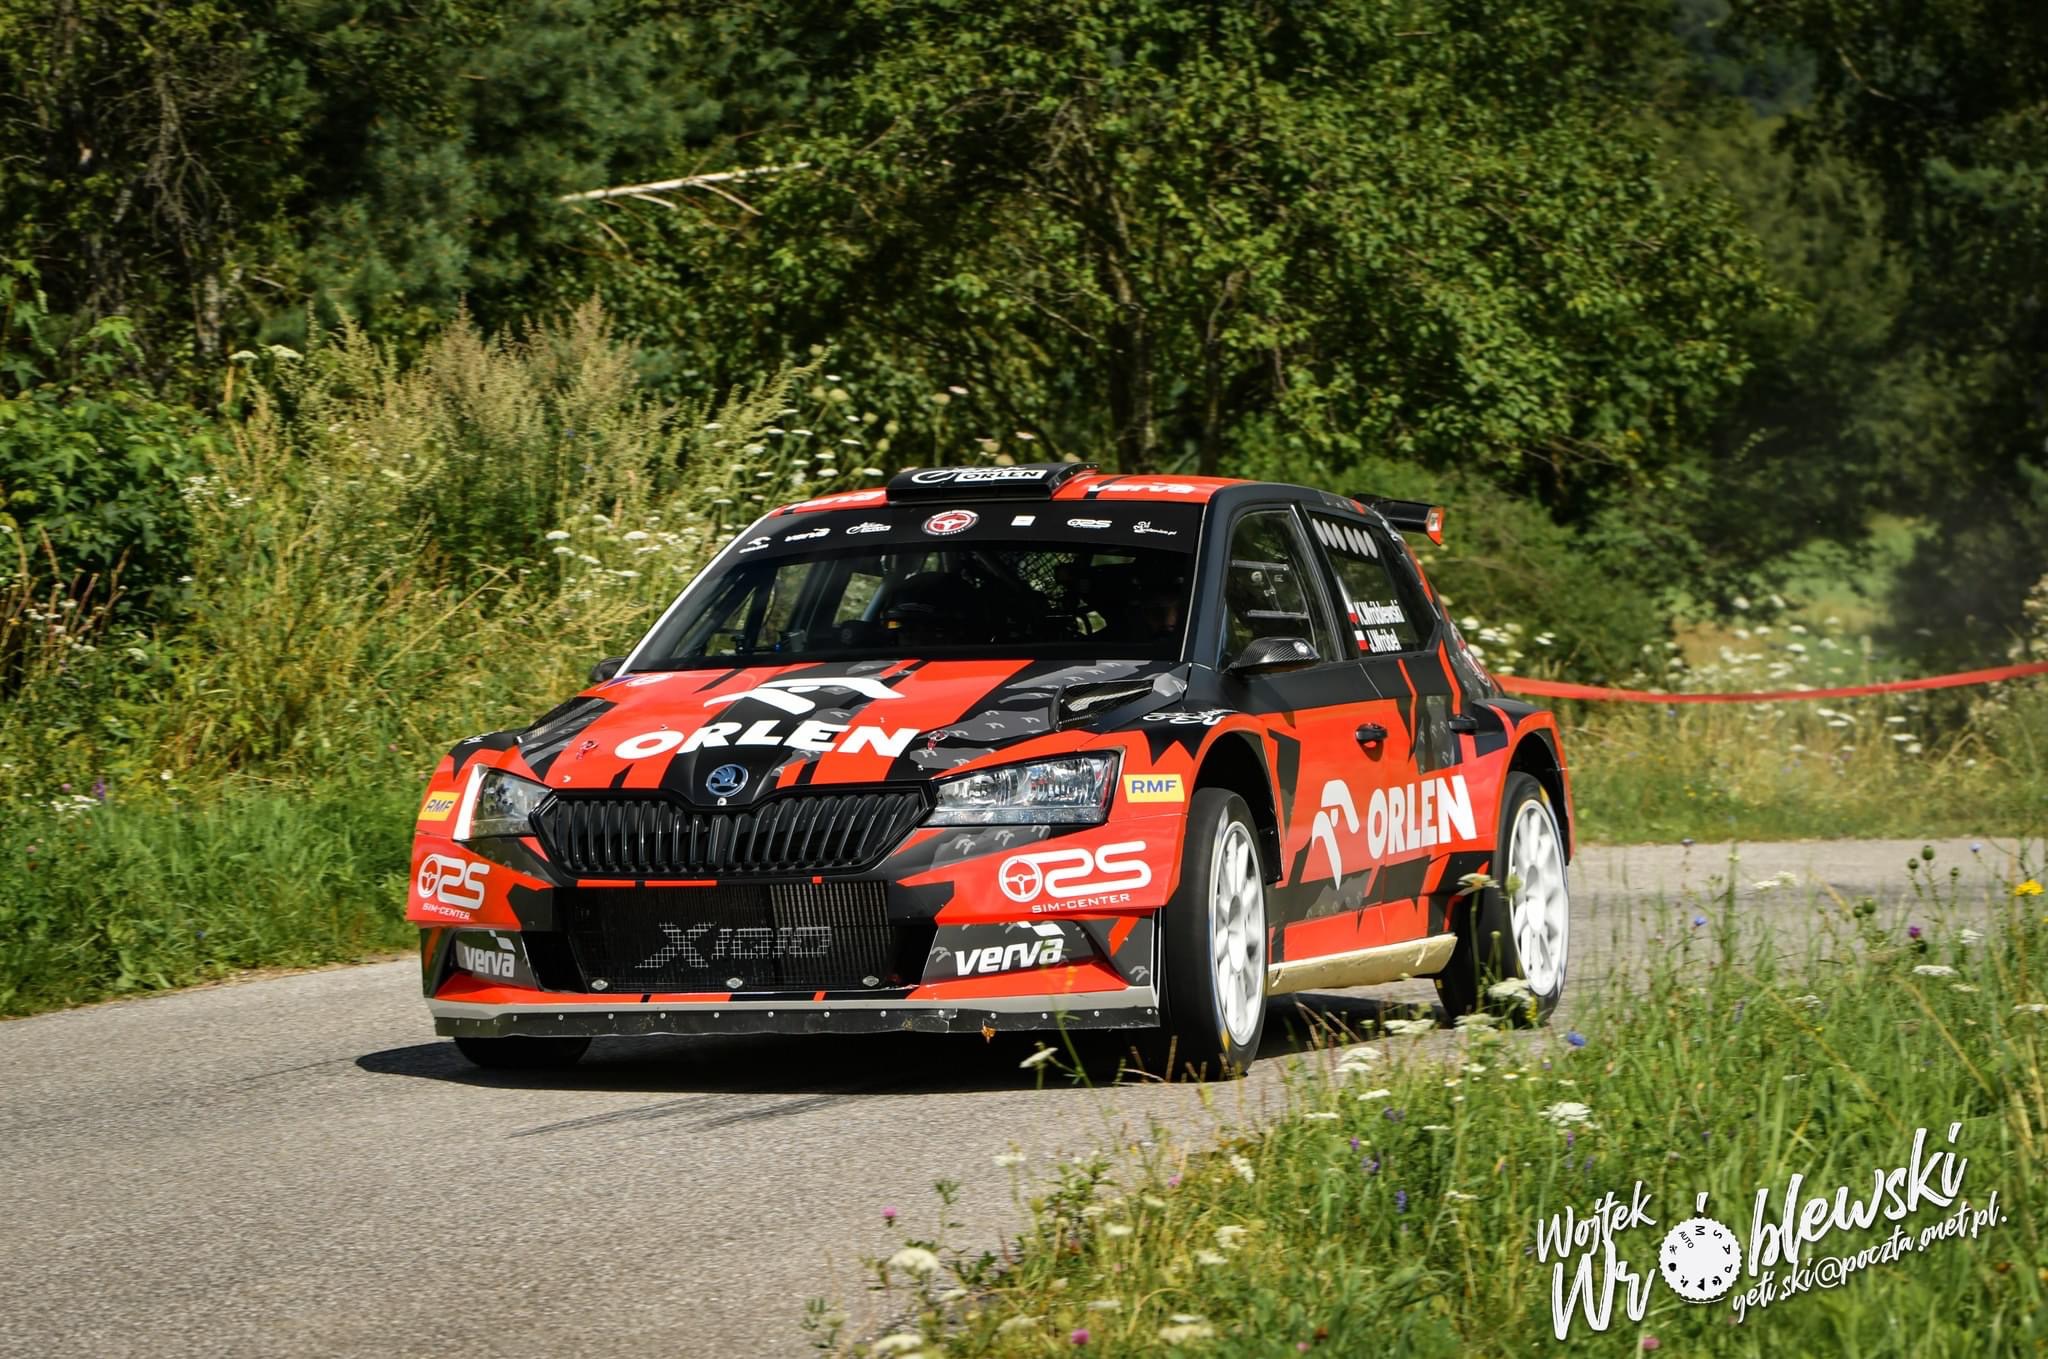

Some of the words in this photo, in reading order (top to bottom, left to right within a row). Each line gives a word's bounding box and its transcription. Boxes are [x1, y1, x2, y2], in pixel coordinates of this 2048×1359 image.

[963, 471, 1039, 480] ORLEN
[614, 719, 921, 759] ORLEN
[1132, 780, 1177, 793] RMF
[424, 799, 454, 812] RMF
[1367, 774, 1477, 860] ORLEN
[422, 902, 471, 920] SIM-CENTER
[1031, 892, 1131, 914] SIM-CENTER
[463, 945, 516, 978] verva
[955, 937, 1064, 976] verva
